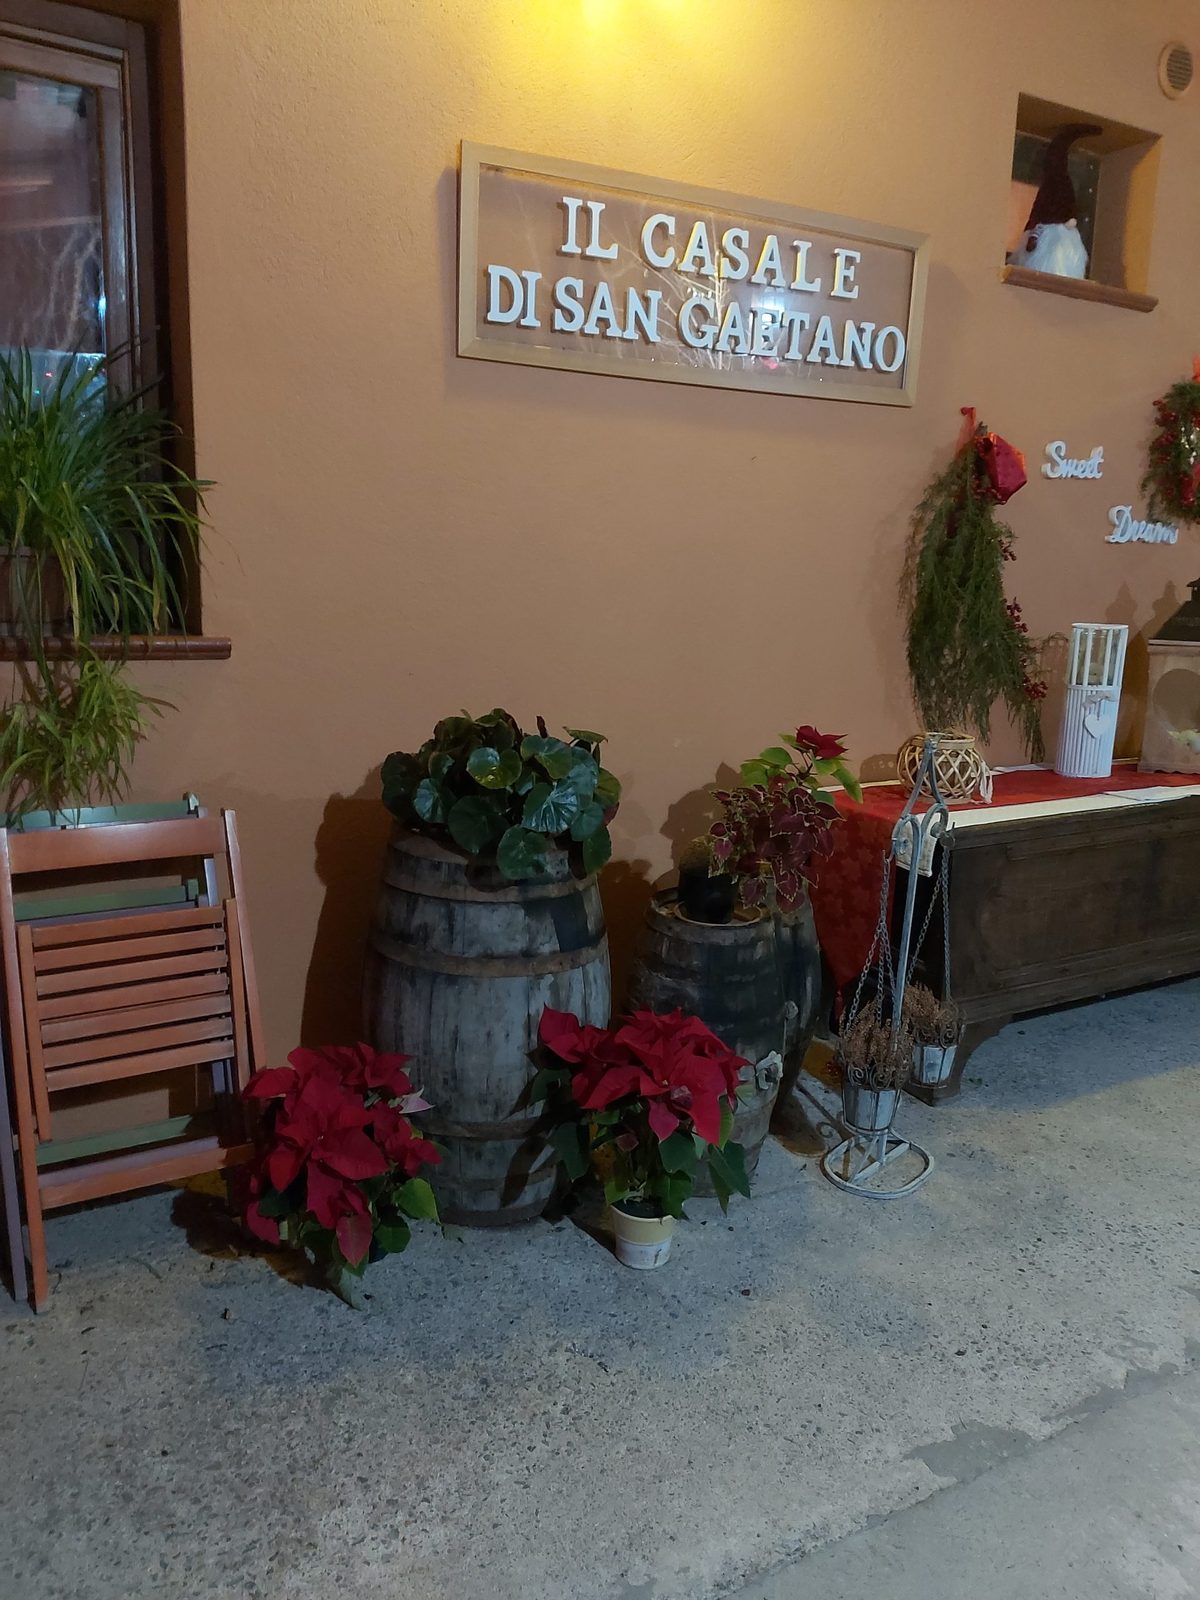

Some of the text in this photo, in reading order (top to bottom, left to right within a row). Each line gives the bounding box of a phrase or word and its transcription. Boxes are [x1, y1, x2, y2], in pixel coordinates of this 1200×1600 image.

[561, 196, 619, 260] IL
[487, 264, 906, 373] DI SAN GAETANO
[1041, 440, 1105, 479] Sweet
